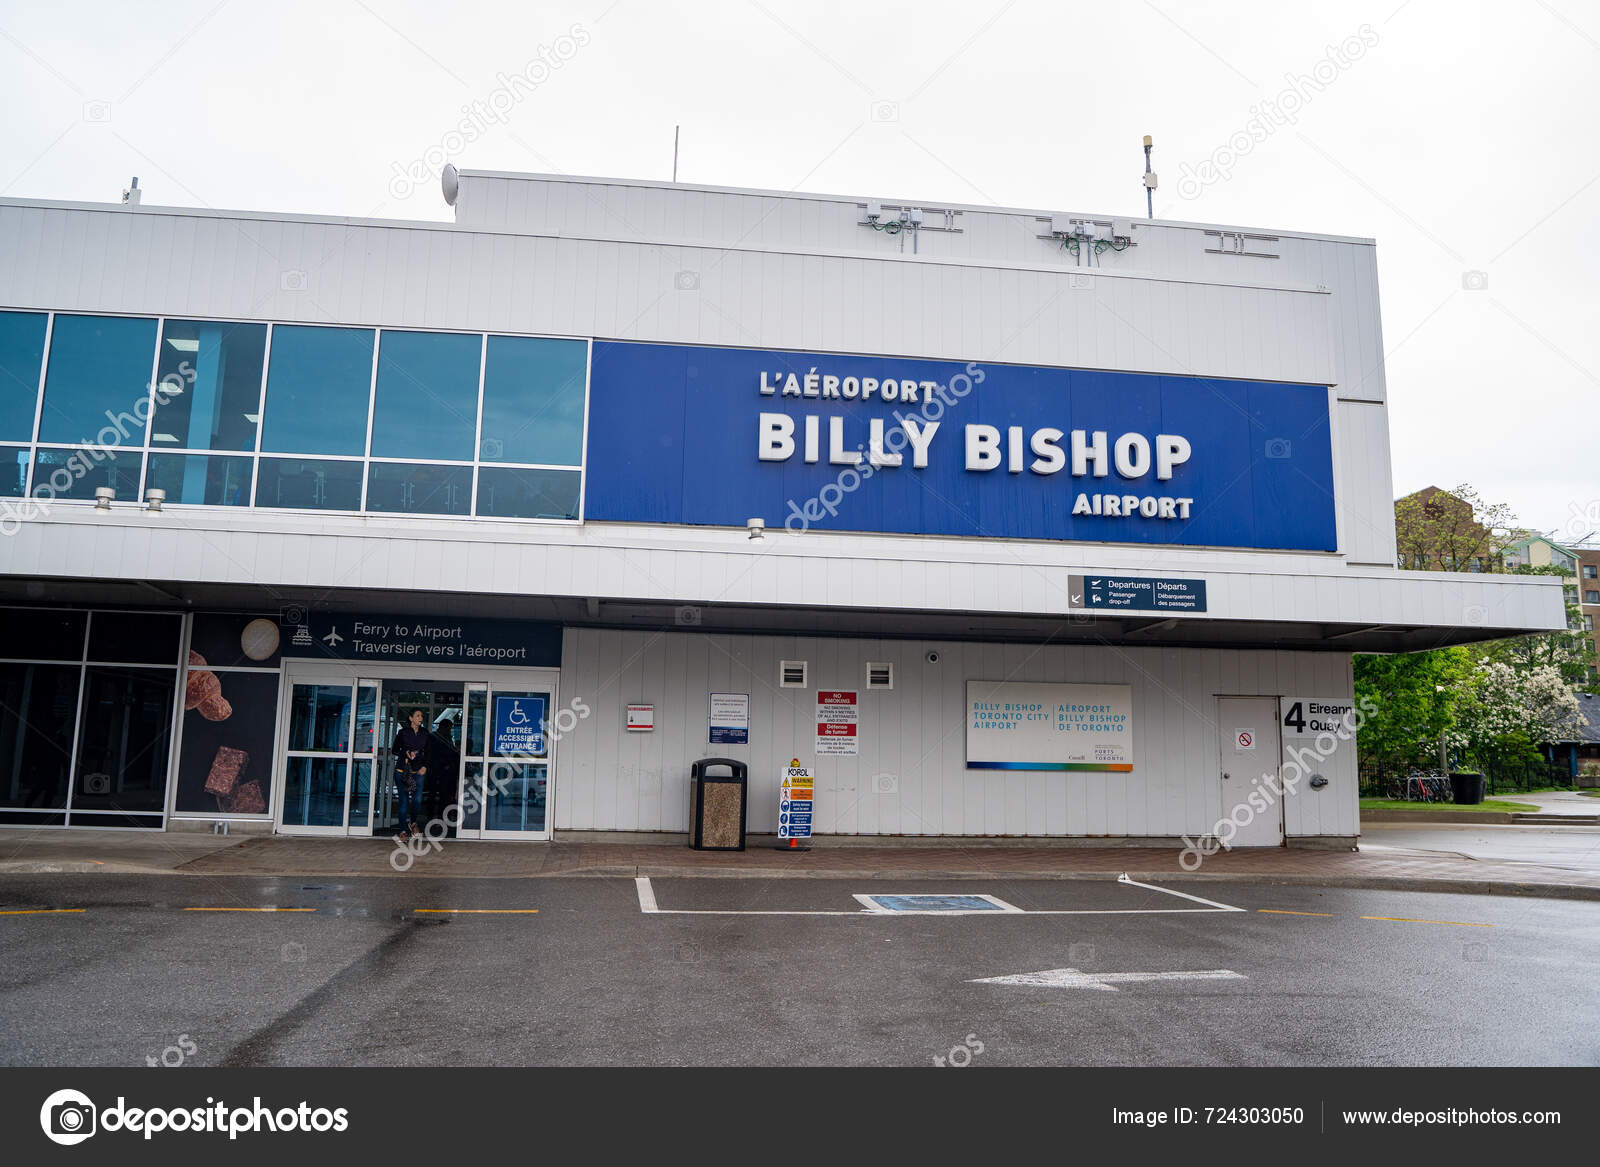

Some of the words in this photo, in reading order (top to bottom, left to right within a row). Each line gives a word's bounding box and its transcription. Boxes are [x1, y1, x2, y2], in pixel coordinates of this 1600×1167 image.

[760, 368, 937, 403] L'AÉROPORT
[759, 412, 940, 469] BILLY
[965, 424, 1191, 480] BISHOP
[1072, 493, 1194, 519] AIRPORT
[1108, 580, 1150, 590] Departures
[1157, 582, 1187, 591] Départs
[1157, 592, 1195, 600] Débarquement
[354, 622, 390, 637] Ferry
[395, 623, 409, 636] to
[413, 624, 462, 640] Airport
[353, 640, 420, 654] Traversier
[425, 645, 455, 655] vers
[459, 643, 526, 660] l'aéroport
[973, 702, 1000, 710] BILLY
[1005, 703, 1042, 712] BISHOP
[974, 712, 1023, 720] TORONTO
[1027, 713, 1049, 721] CITY
[1058, 714, 1085, 722] BILLY
[1089, 715, 1126, 723] BISHOP
[1284, 702, 1306, 733] 4
[1309, 703, 1352, 715] Eireann
[506, 726, 533, 734] ENTRÉE
[974, 722, 1017, 730] AIRPORT
[1058, 723, 1071, 731] DE
[1076, 724, 1124, 732] TORONTO
[1310, 720, 1341, 733] Quay
[498, 734, 540, 742] ACCESSIBLE
[500, 742, 537, 750] ENTRANCE
